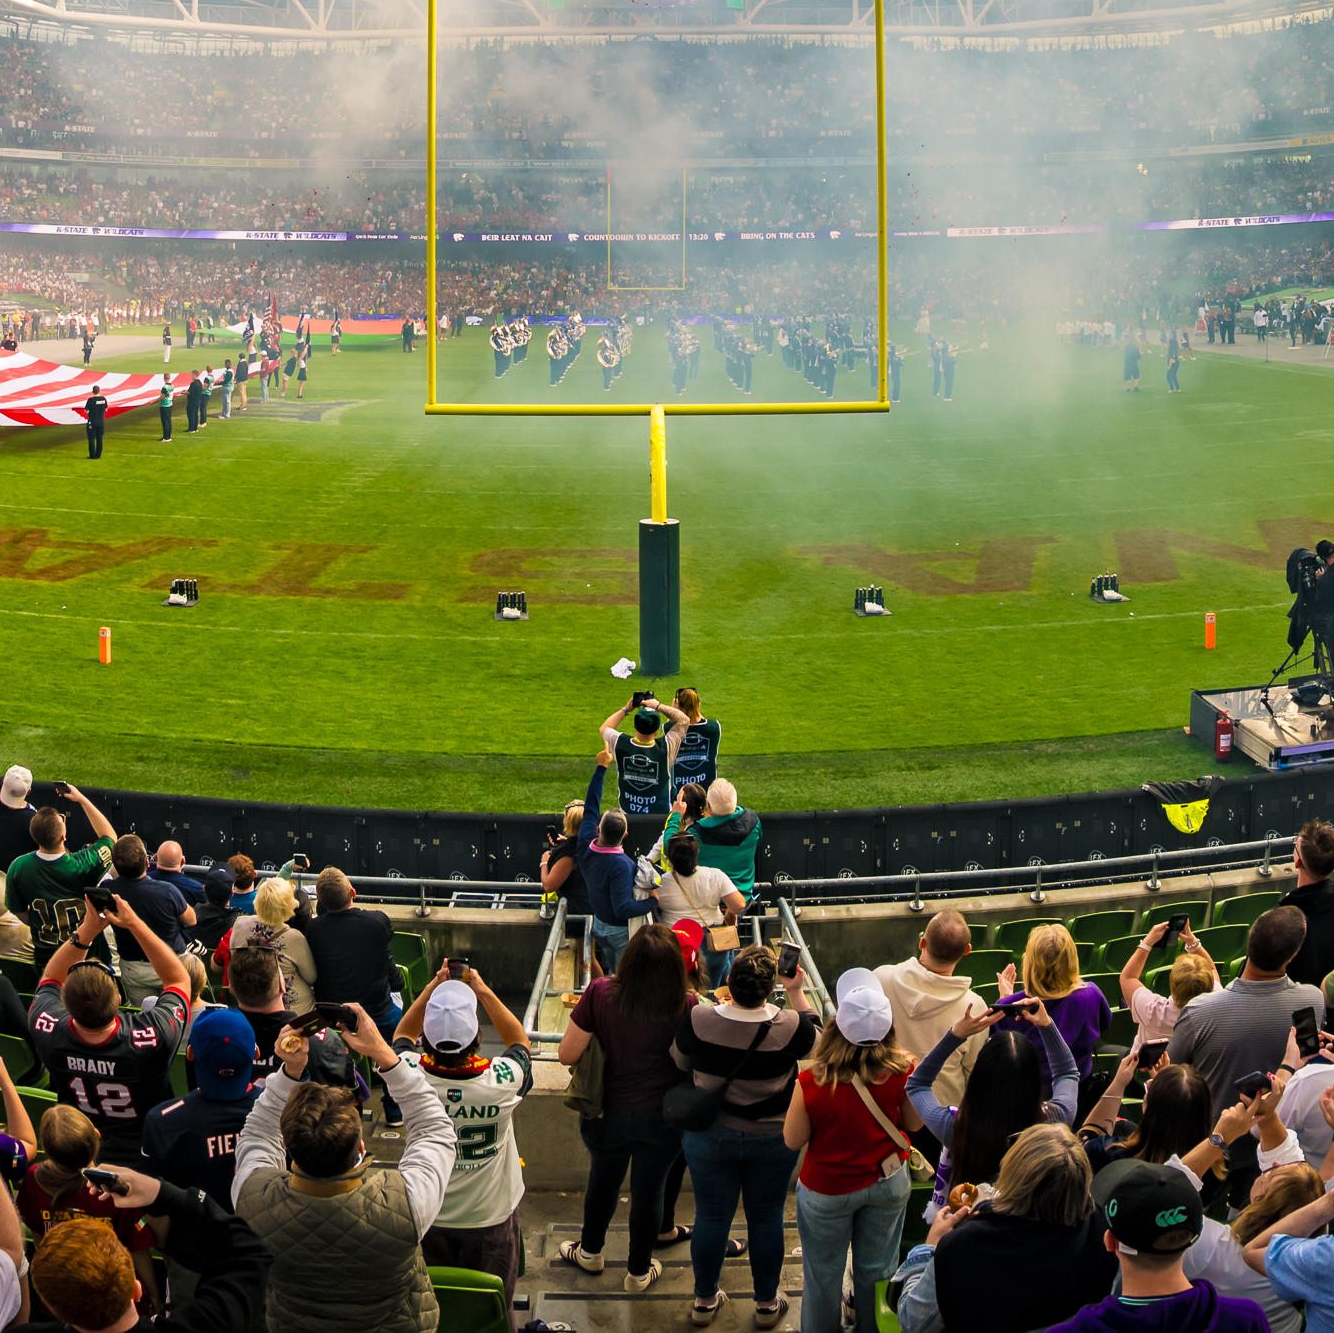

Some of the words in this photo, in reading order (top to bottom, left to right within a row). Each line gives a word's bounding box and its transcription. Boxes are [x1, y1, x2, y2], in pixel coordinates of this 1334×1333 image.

[1303, 107, 1331, 116] K-STATE
[65, 125, 96, 133] K-STATE
[1309, 136, 1331, 145] AVIVA
[1245, 216, 1281, 225] WILDCATS
[104, 228, 144, 236] WILDCATS
[296, 232, 337, 240] WILDCATS
[741, 232, 764, 240] BRING
[676, 773, 706, 786] PHOTO
[625, 793, 656, 804] PHOTO
[629, 803, 648, 813] 074
[28, 898, 88, 946] 10
[132, 1026, 157, 1049] 12
[67, 1056, 116, 1077] BRADY
[69, 1077, 137, 1119] 12
[447, 1105, 500, 1119] LAND
[455, 1124, 499, 1160] 2
